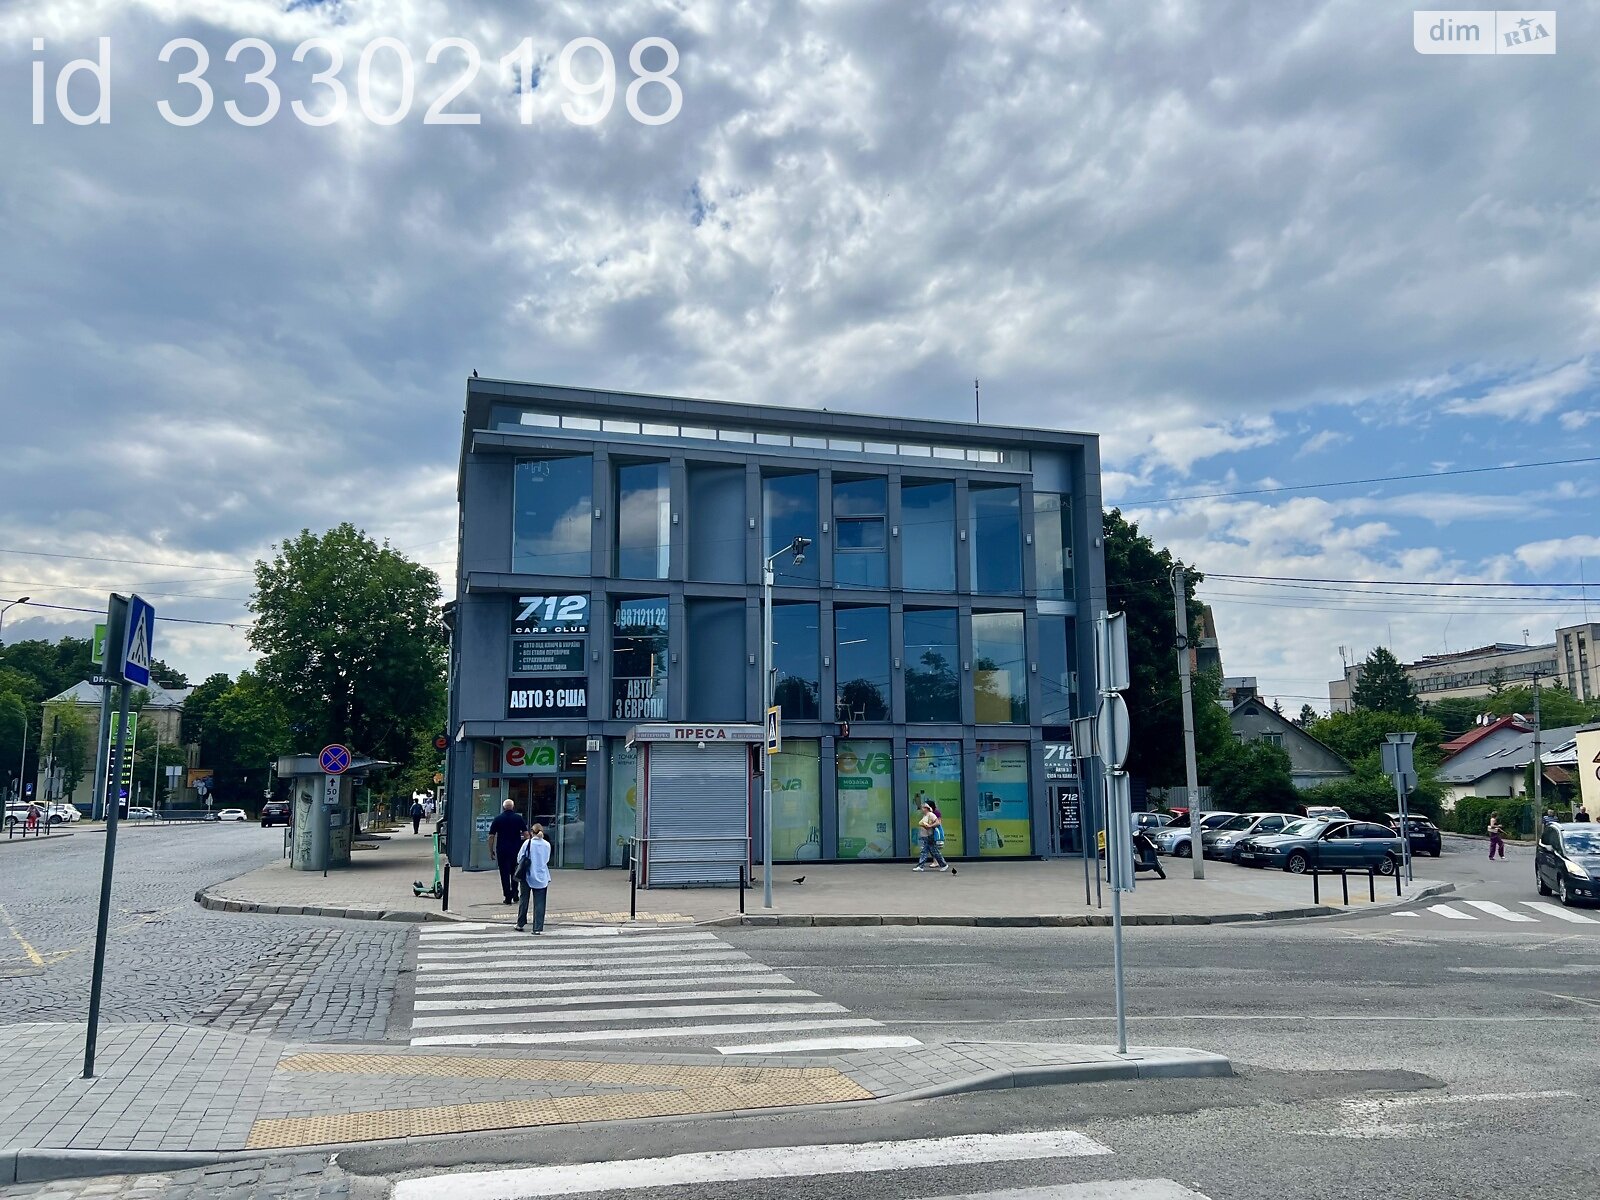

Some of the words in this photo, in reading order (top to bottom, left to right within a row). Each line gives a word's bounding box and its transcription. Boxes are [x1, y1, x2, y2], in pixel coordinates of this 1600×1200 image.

[515, 595, 587, 621] 712
[510, 690, 543, 709] АВТО
[545, 689, 554, 708] З
[556, 689, 586, 708] США
[627, 679, 653, 699] АВТО
[615, 698, 622, 719] З
[624, 698, 664, 719] ЄВРОПИ
[674, 728, 727, 739] ПРЕСА
[506, 744, 555, 767] eva
[1044, 745, 1074, 760] 712
[327, 788, 337, 796] 50
[1061, 793, 1078, 801] 712
